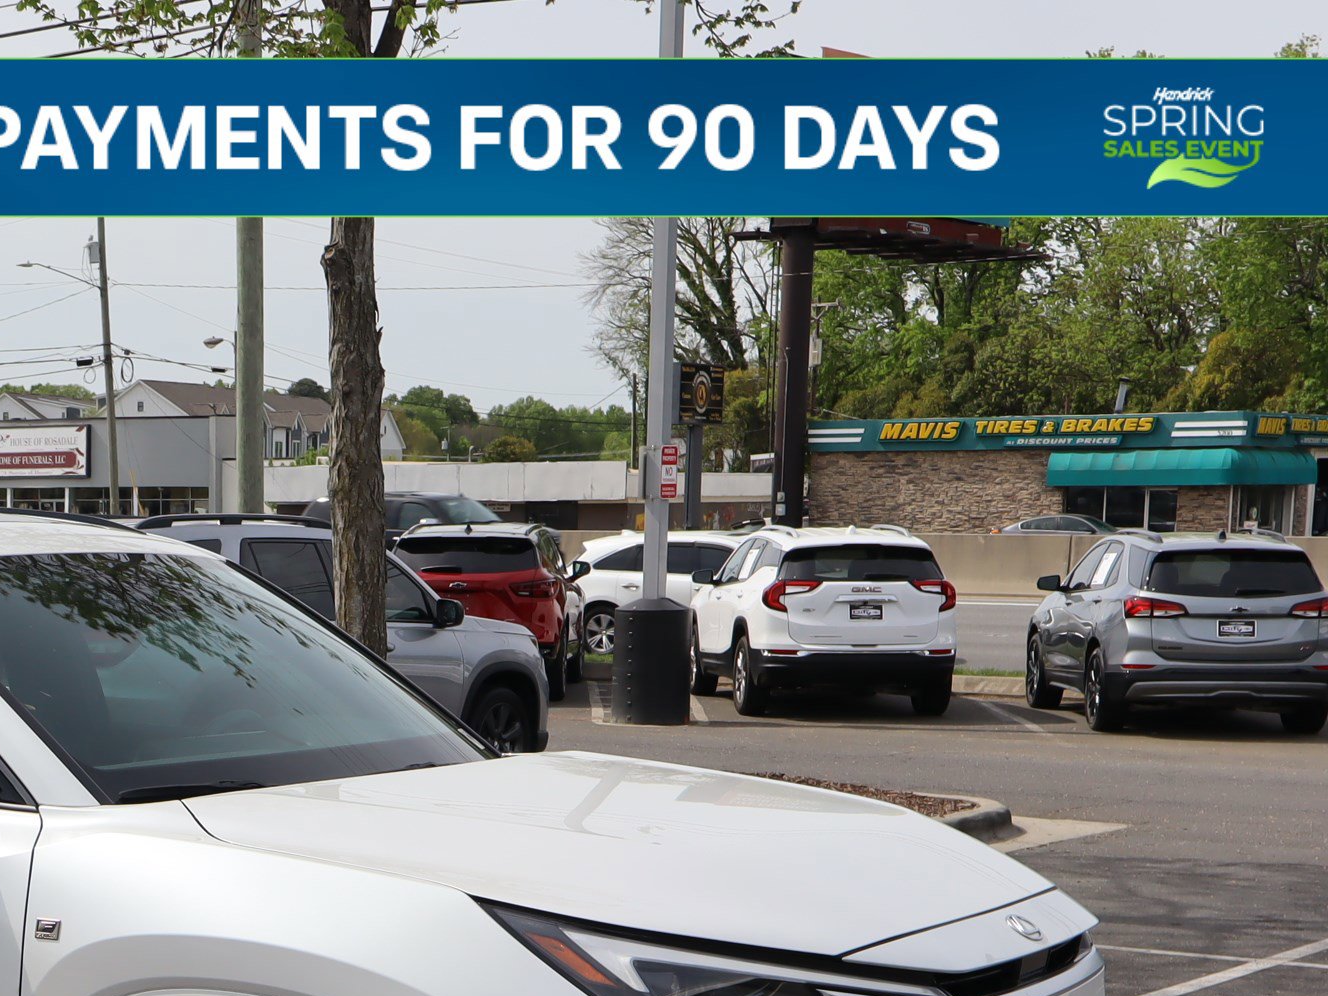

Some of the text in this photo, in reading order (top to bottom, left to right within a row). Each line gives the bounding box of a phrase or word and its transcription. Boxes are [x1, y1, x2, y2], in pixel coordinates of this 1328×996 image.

[879, 417, 1154, 440] MAVIS TIRES & BRAKES
[1256, 417, 1287, 435] MAVIS
[10, 438, 32, 447] HOUSE
[33, 438, 42, 446] OF
[44, 437, 78, 446] ROSADALE
[1076, 437, 1118, 445] PRICES
[12, 456, 22, 465] OF
[22, 455, 54, 465] FUNERALS,
[54, 455, 67, 464] LLC
